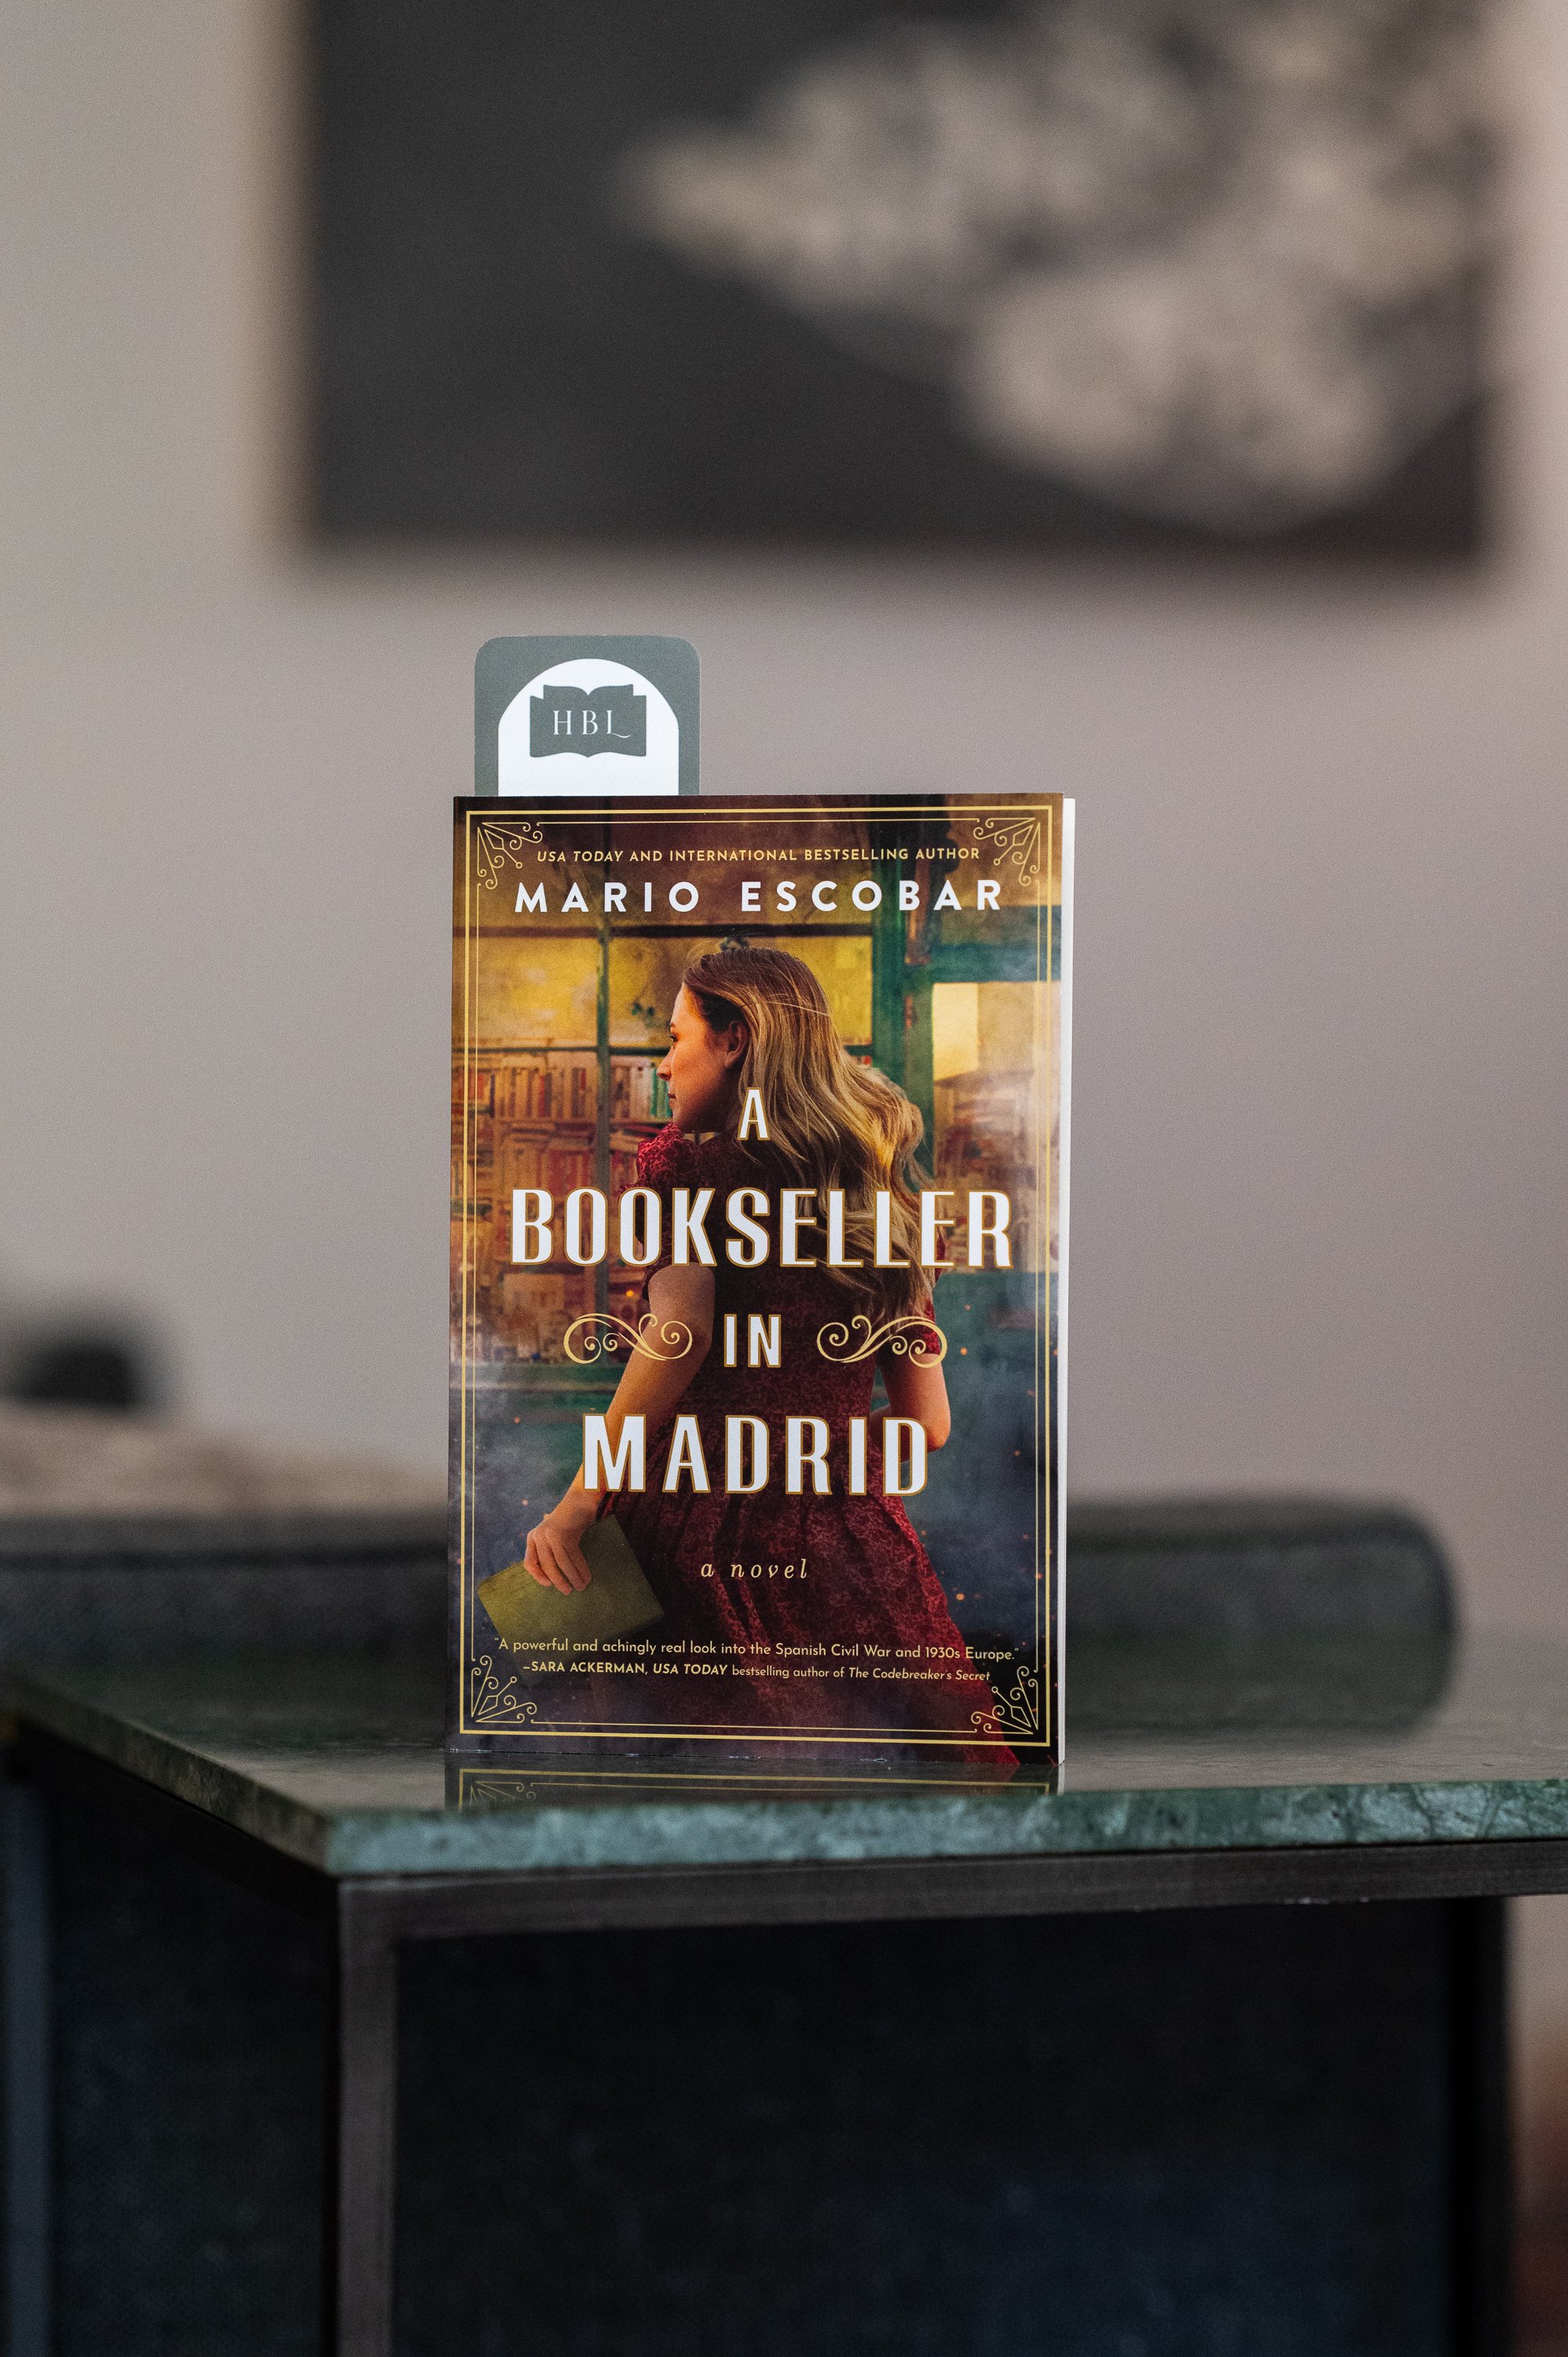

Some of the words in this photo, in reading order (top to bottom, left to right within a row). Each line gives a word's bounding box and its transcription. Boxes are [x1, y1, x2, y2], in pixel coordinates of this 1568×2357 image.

[553, 709, 632, 739] HBL
[537, 851, 566, 862] USA
[573, 850, 624, 862] TODAY
[629, 850, 663, 862] AND
[669, 849, 797, 862] INTERNATIONAL
[804, 849, 909, 860] BESTSELLING
[915, 848, 980, 860] AUTHOR
[515, 881, 699, 913] MARIO
[742, 879, 1002, 912] ESCOBAR
[737, 1087, 771, 1141] A
[510, 1187, 1013, 1270] BOOKSELLER
[724, 1314, 782, 1369] IN
[582, 1413, 929, 1496] MADRID
[700, 1563, 715, 1578] a
[731, 1558, 808, 1579] novel
[513, 1637, 569, 1653] powerful
[573, 1638, 598, 1651] and
[602, 1639, 657, 1655] achingly
[661, 1640, 686, 1653] real
[690, 1640, 716, 1654] look
[721, 1642, 746, 1655] into
[749, 1640, 771, 1655] the
[775, 1643, 826, 1659] Spanish
[831, 1644, 859, 1657] Civil
[864, 1644, 891, 1658] War
[896, 1645, 921, 1659] and
[925, 1646, 961, 1659] 1930s
[570, 1662, 648, 1676] ACKERMAN,
[653, 1663, 679, 1675] USA
[683, 1664, 727, 1675] TODAY
[732, 1664, 789, 1679] bestselling
[793, 1666, 830, 1677] author
[833, 1666, 845, 1677] of
[848, 1667, 869, 1678] The
[873, 1667, 952, 1681] Codebreaker's
[955, 1670, 991, 1681] Secret
